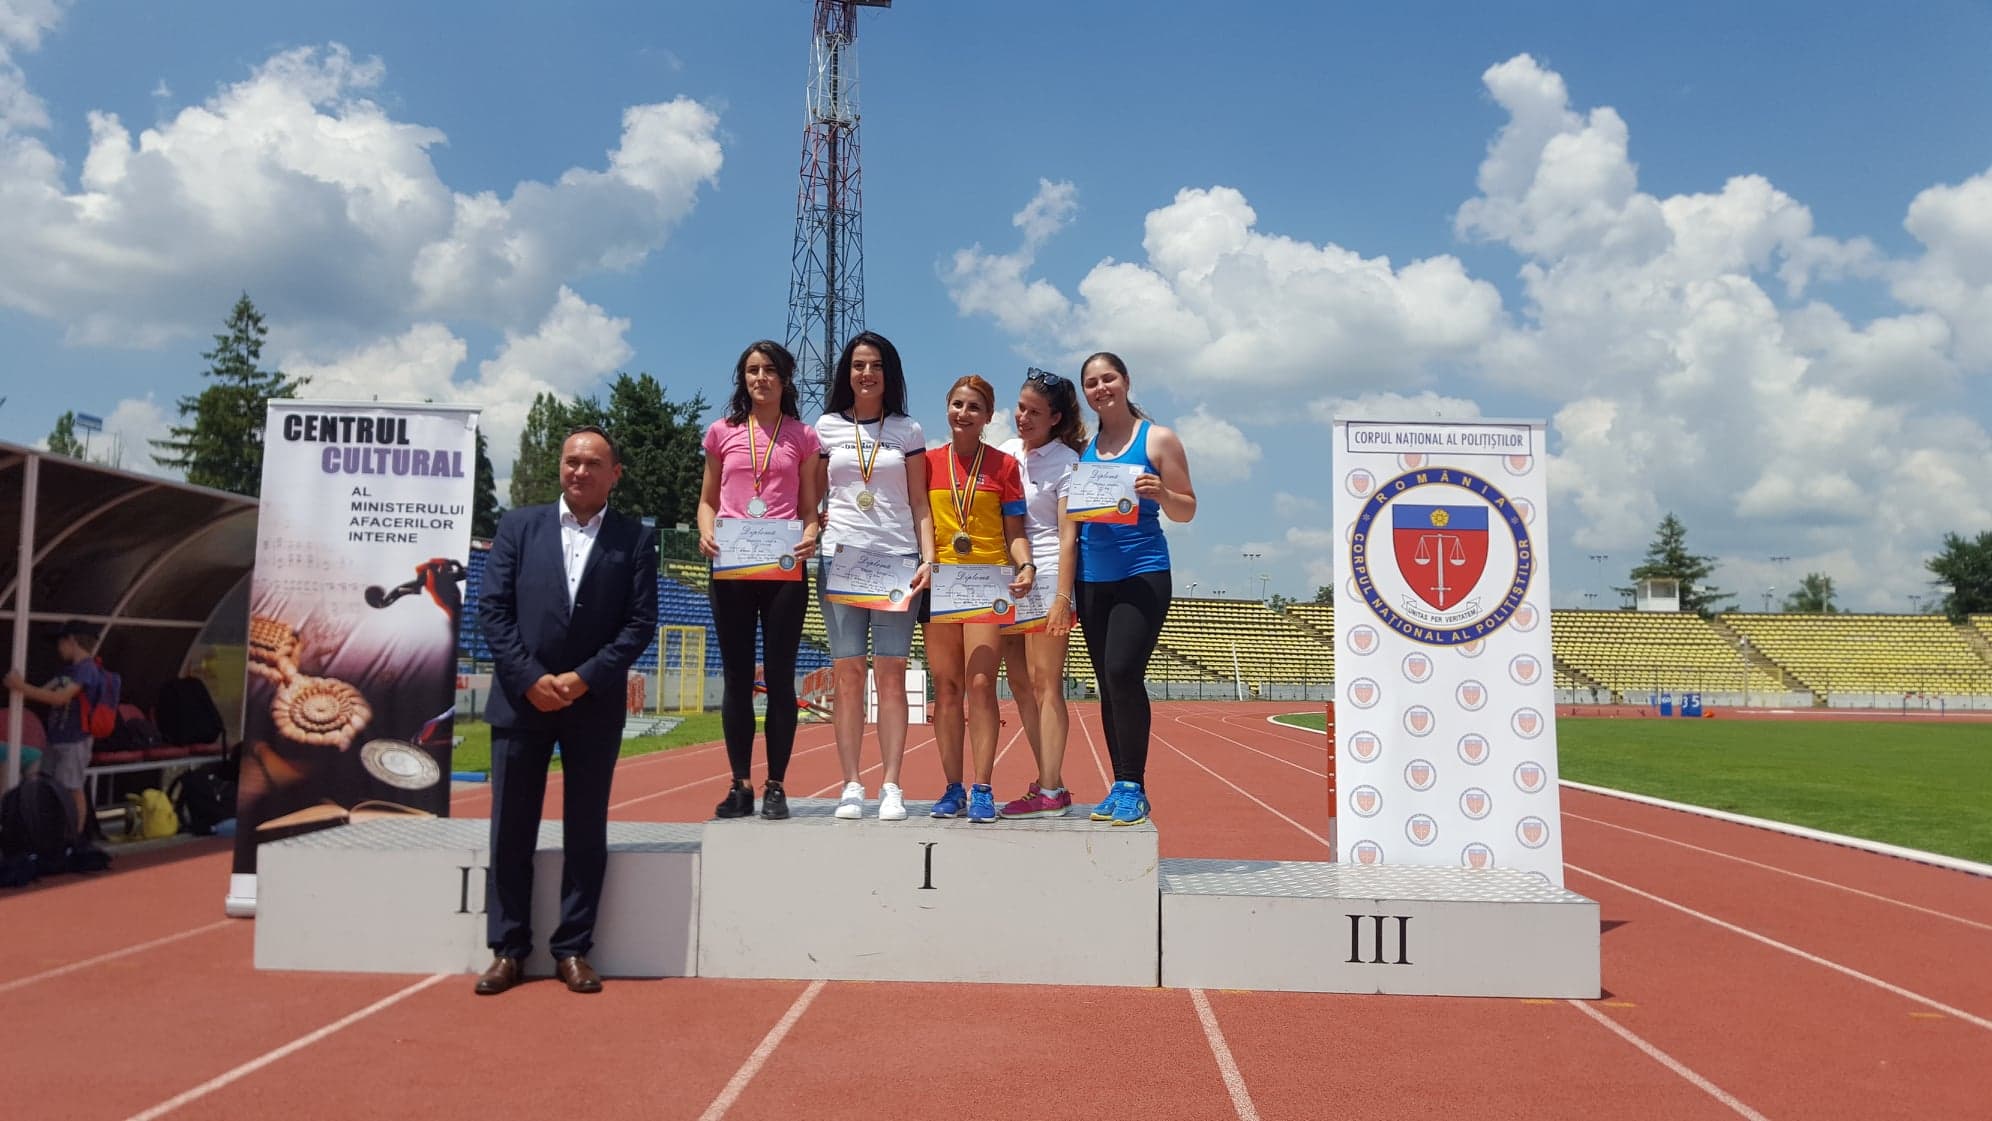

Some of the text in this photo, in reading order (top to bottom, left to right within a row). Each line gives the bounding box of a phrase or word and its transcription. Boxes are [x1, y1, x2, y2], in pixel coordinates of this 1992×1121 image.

[283, 414, 410, 445] CENTRUL
[1354, 431, 1392, 445] CORPUL
[1446, 433, 1457, 445] AL
[321, 446, 465, 478] CULTURAL
[351, 486, 371, 497] AL
[351, 502, 464, 515] MINISTERULUI
[350, 517, 454, 530] AFACERILOR
[349, 532, 418, 544] INTERNE
[1353, 533, 1373, 595] CORPUL
[1452, 630, 1470, 641] AL
[917, 842, 938, 890] I
[1344, 914, 1414, 965] III
